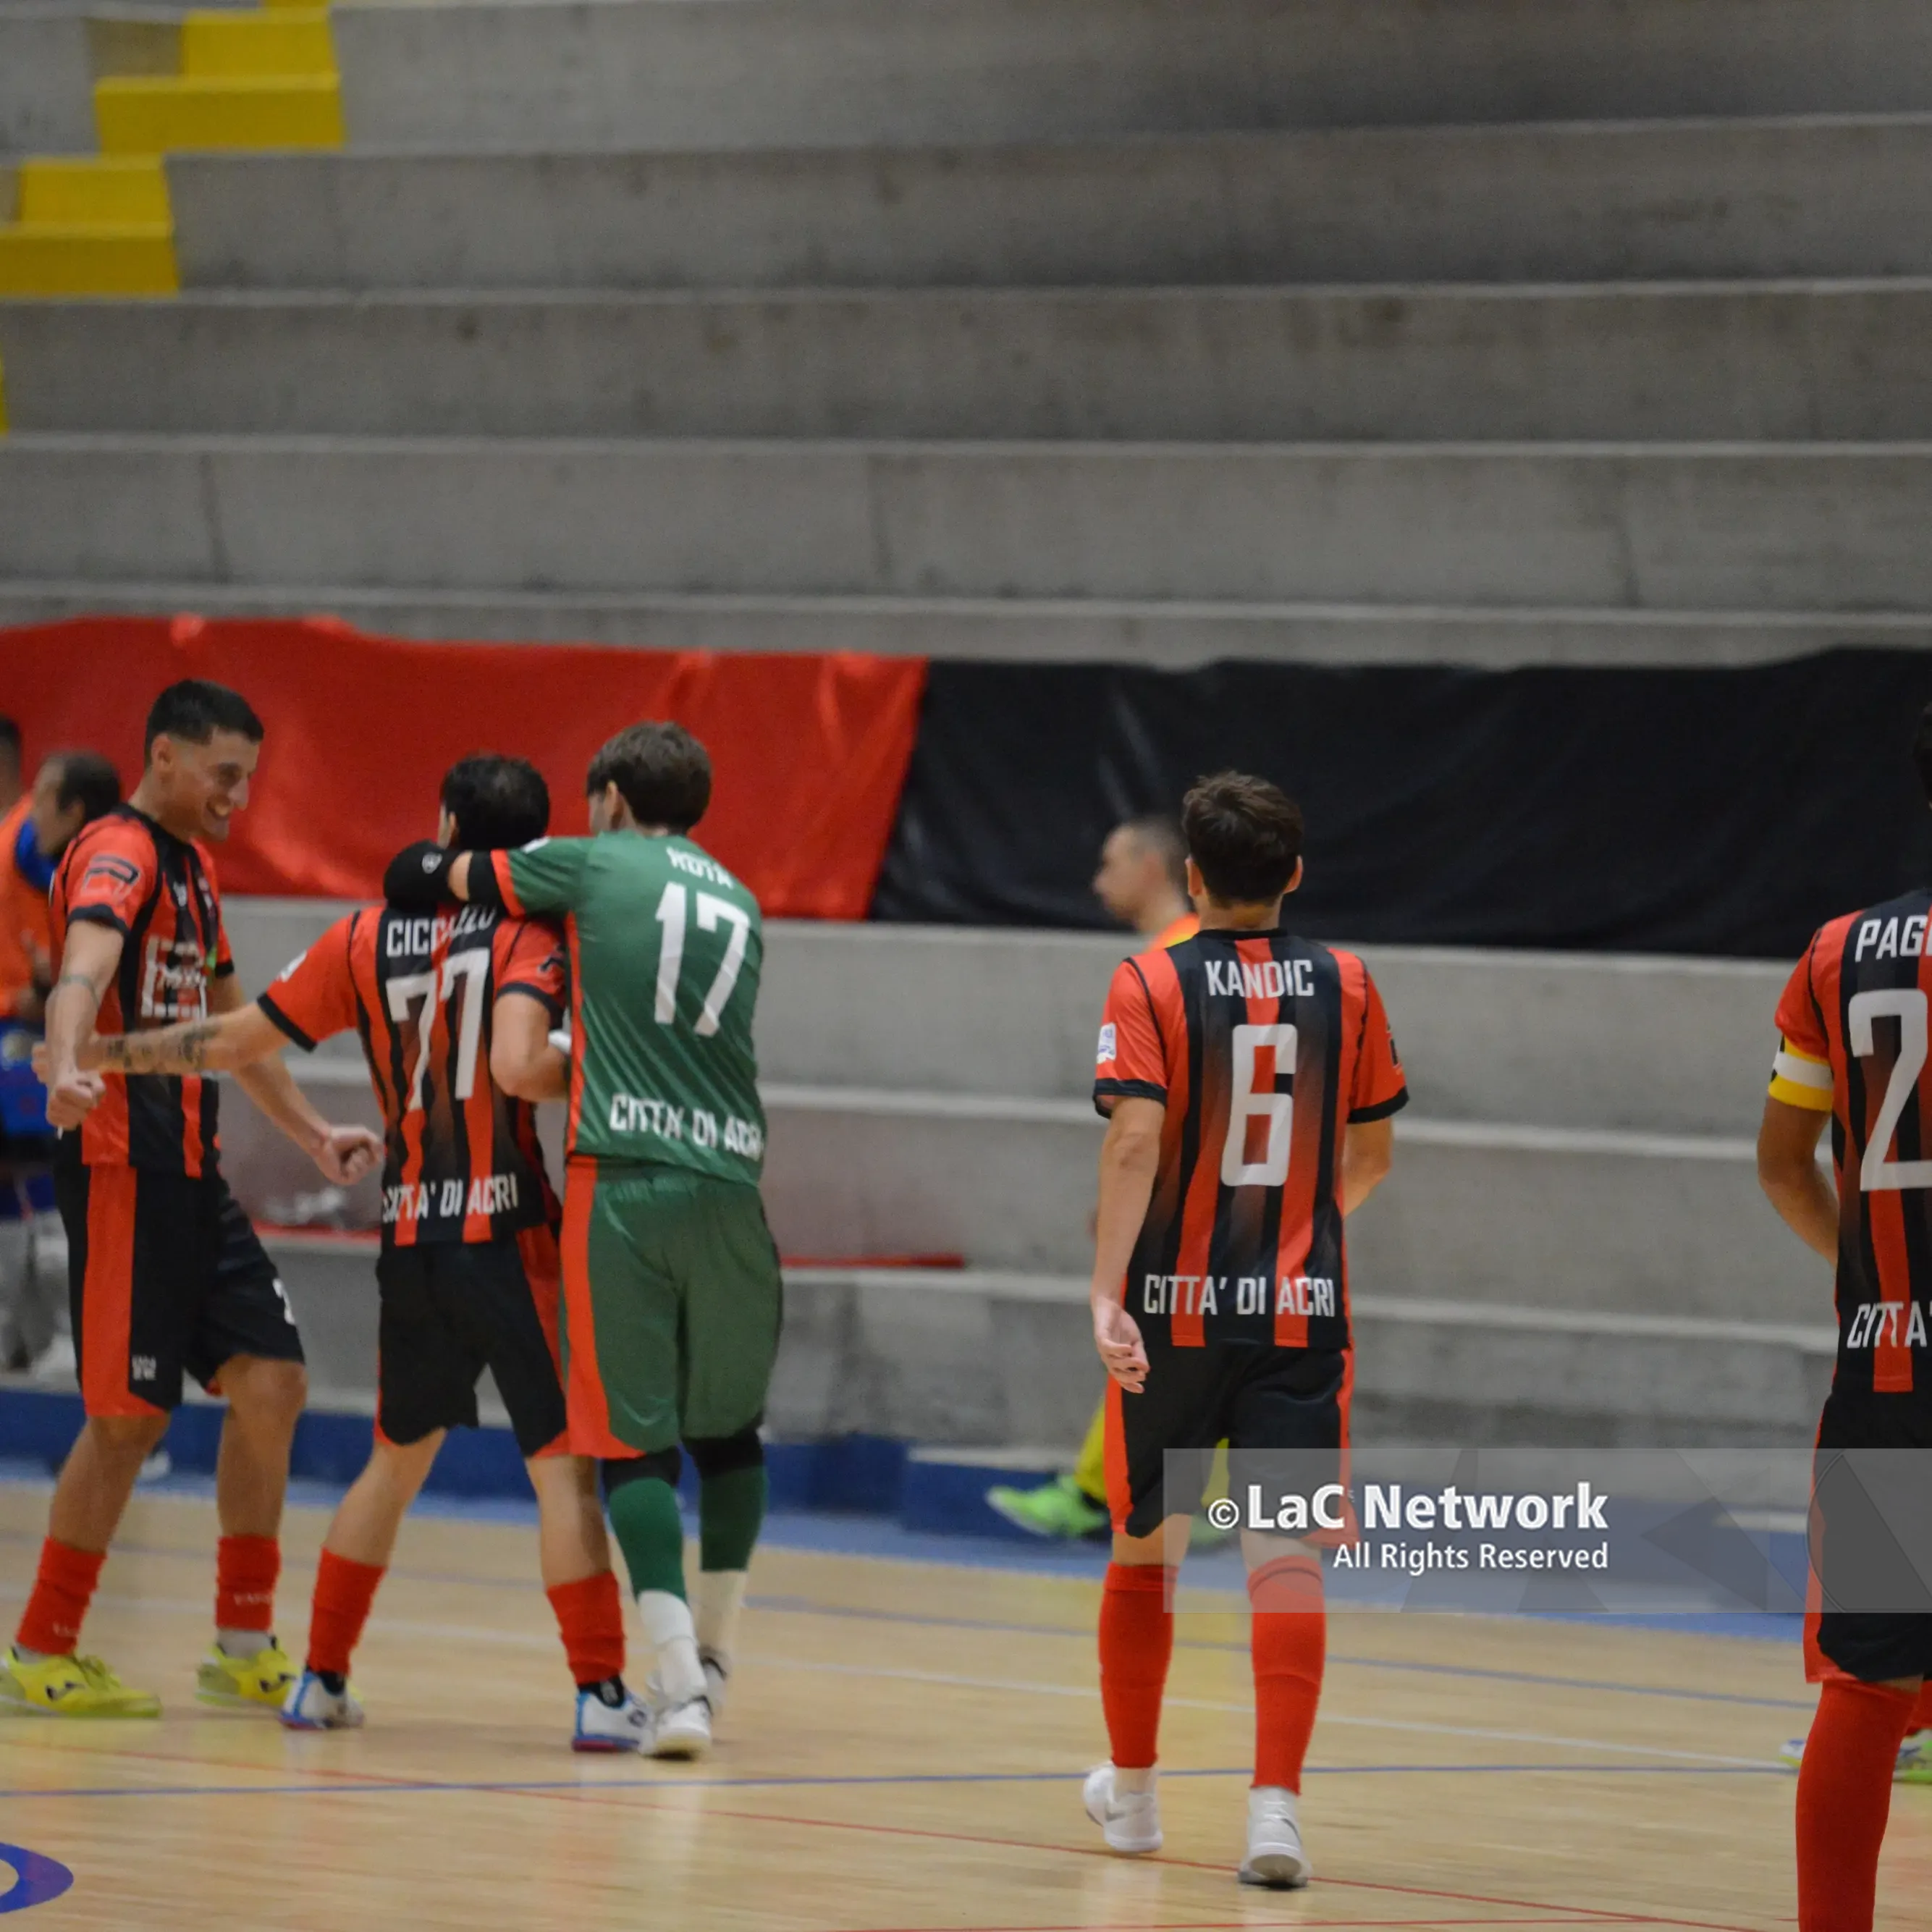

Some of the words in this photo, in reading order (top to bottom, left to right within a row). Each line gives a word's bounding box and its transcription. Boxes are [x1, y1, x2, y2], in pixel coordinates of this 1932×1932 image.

[654, 882, 750, 1037] 17
[1855, 914, 1932, 963] PAG
[1205, 959, 1315, 999] KANDIC
[386, 948, 491, 1111] 77
[1220, 1024, 1298, 1187] 6
[692, 1108, 718, 1150] DI
[724, 1114, 764, 1161] ACR
[439, 1178, 464, 1218] DI
[465, 1171, 518, 1215] ACRI
[1143, 1274, 1228, 1316] CITTA'
[1236, 1277, 1266, 1315] DI
[1276, 1276, 1336, 1317] ACRI
